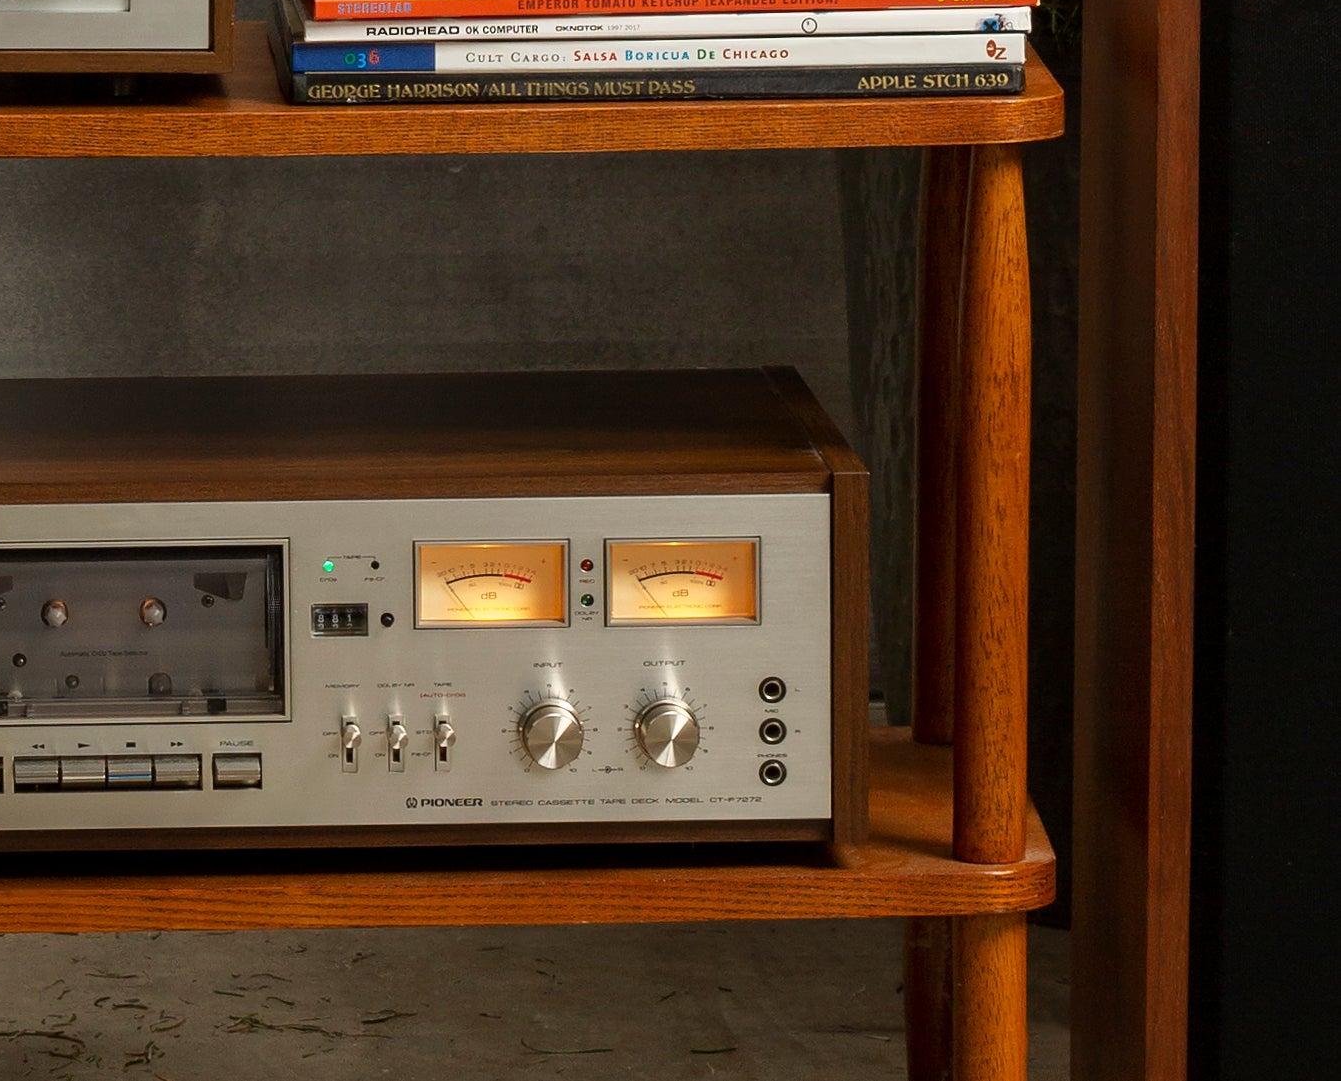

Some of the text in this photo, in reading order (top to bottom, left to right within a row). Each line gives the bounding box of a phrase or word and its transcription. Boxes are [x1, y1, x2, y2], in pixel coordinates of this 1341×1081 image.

[337, 2, 412, 14] STEREOLAB
[366, 26, 460, 37] RADIOHEAD
[465, 25, 480, 35] OK
[482, 24, 539, 35] COMPUTER
[344, 49, 380, 69] 036
[573, 49, 618, 62] SALSA
[722, 48, 789, 60] CHICAGO
[308, 84, 381, 99] GEORGE
[388, 83, 479, 98] HARRISON
[525, 81, 589, 96] THINGS
[593, 81, 645, 96] MUST
[648, 80, 696, 94] PASS
[857, 75, 916, 90] APPLE
[923, 74, 970, 88] STCH
[974, 74, 1009, 88] 639
[480, 592, 497, 600] dB
[672, 589, 689, 597] dB
[317, 614, 325, 623] 8
[332, 614, 339, 623] 8
[420, 798, 483, 807] PIONEER
[491, 799, 534, 807] STEREO
[599, 798, 626, 806] TAPE
[631, 797, 659, 805] DECK
